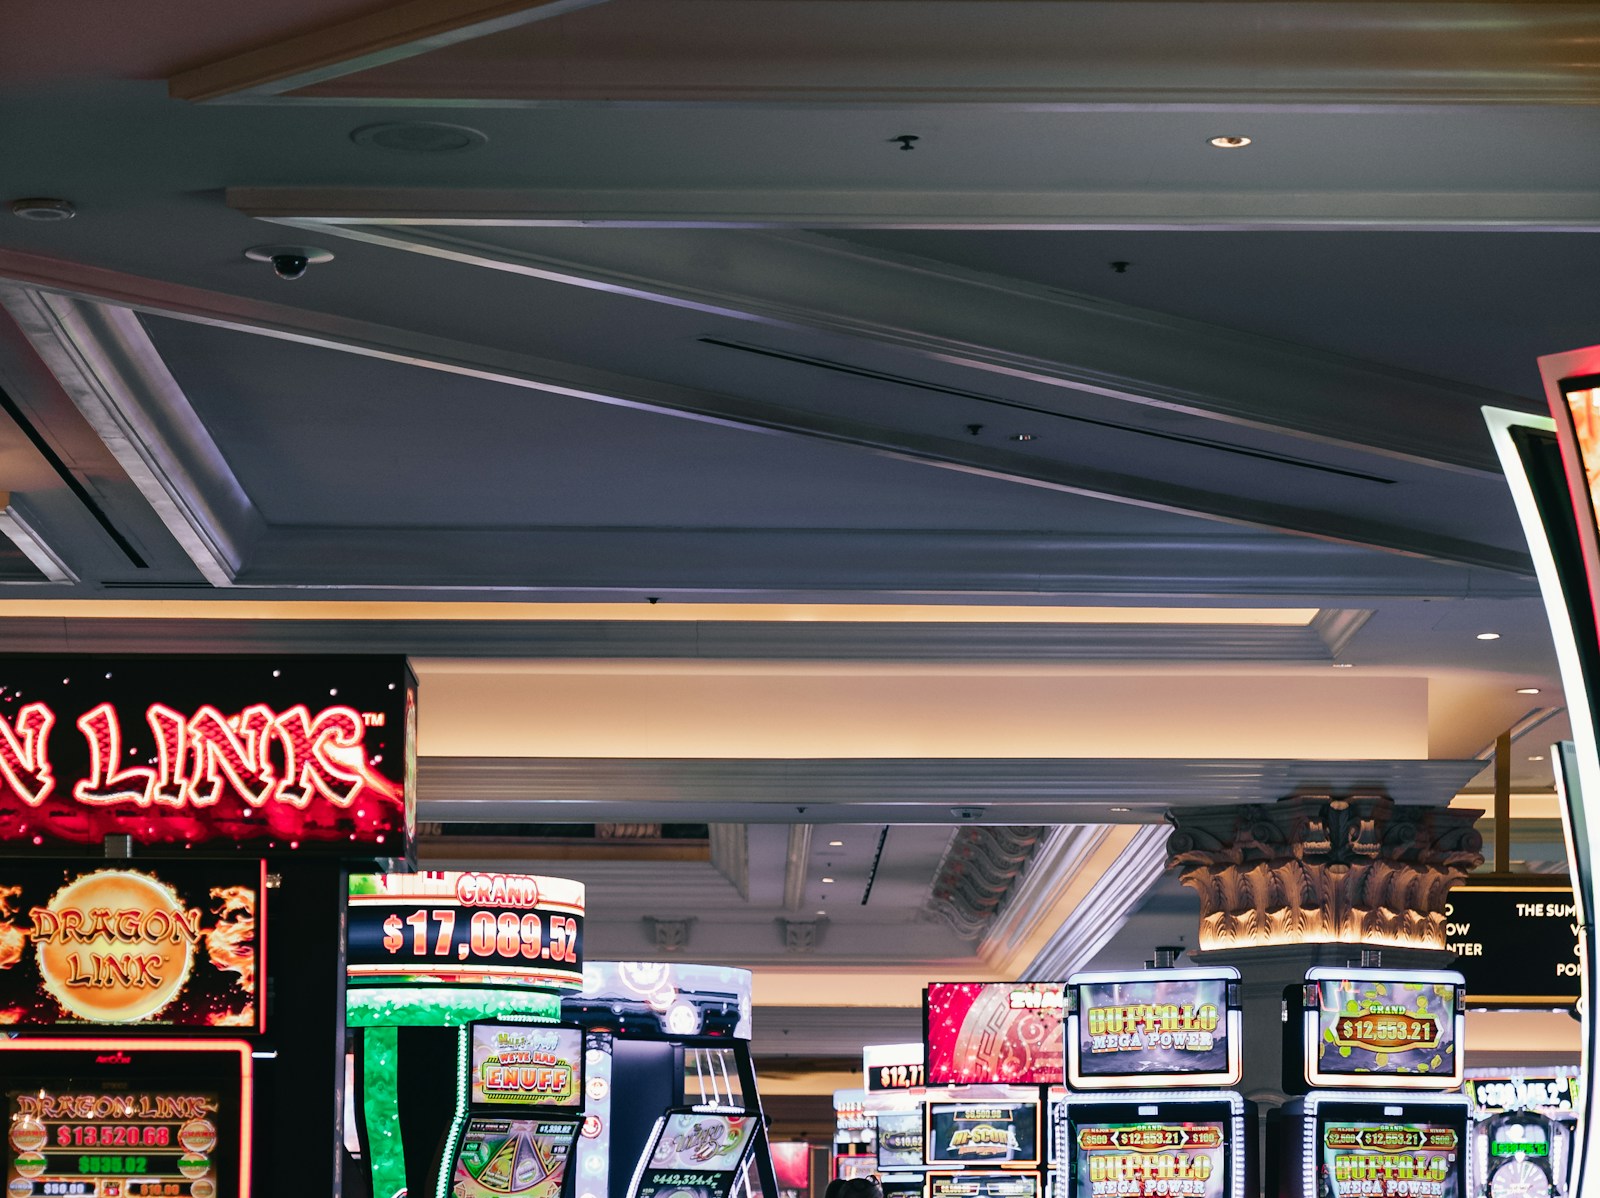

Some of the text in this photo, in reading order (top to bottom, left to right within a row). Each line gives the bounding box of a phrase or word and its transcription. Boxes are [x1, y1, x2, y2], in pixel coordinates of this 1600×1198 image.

[73, 702, 365, 807] LINK
[457, 874, 538, 907] GRAND
[1516, 904, 1544, 917] THE
[30, 908, 201, 945] DRAGON
[383, 909, 577, 963] $17,089.52
[65, 953, 164, 989] LINK
[1088, 1004, 1218, 1036] BUFFALO
[1370, 1005, 1406, 1014] GRAND
[1343, 1020, 1430, 1040] $12,553.21
[1092, 1032, 1213, 1053] MEGA POWER
[498, 1051, 557, 1065] WE'VE HAD
[487, 1067, 567, 1092] ENUFF
[17, 1096, 207, 1119] DRAGON LINK
[57, 1125, 169, 1146] $13,520.68
[1086, 1134, 1107, 1144] $500
[1121, 1132, 1179, 1145] $12,553.21
[1329, 1134, 1356, 1144] $2,500
[1365, 1133, 1418, 1145] $12,553.21
[1089, 1154, 1212, 1182] BUFFALO
[1335, 1155, 1448, 1181] BUFFALO
[1092, 1180, 1206, 1198] MEGA POWER
[1339, 1180, 1443, 1198] MEGA POWER
